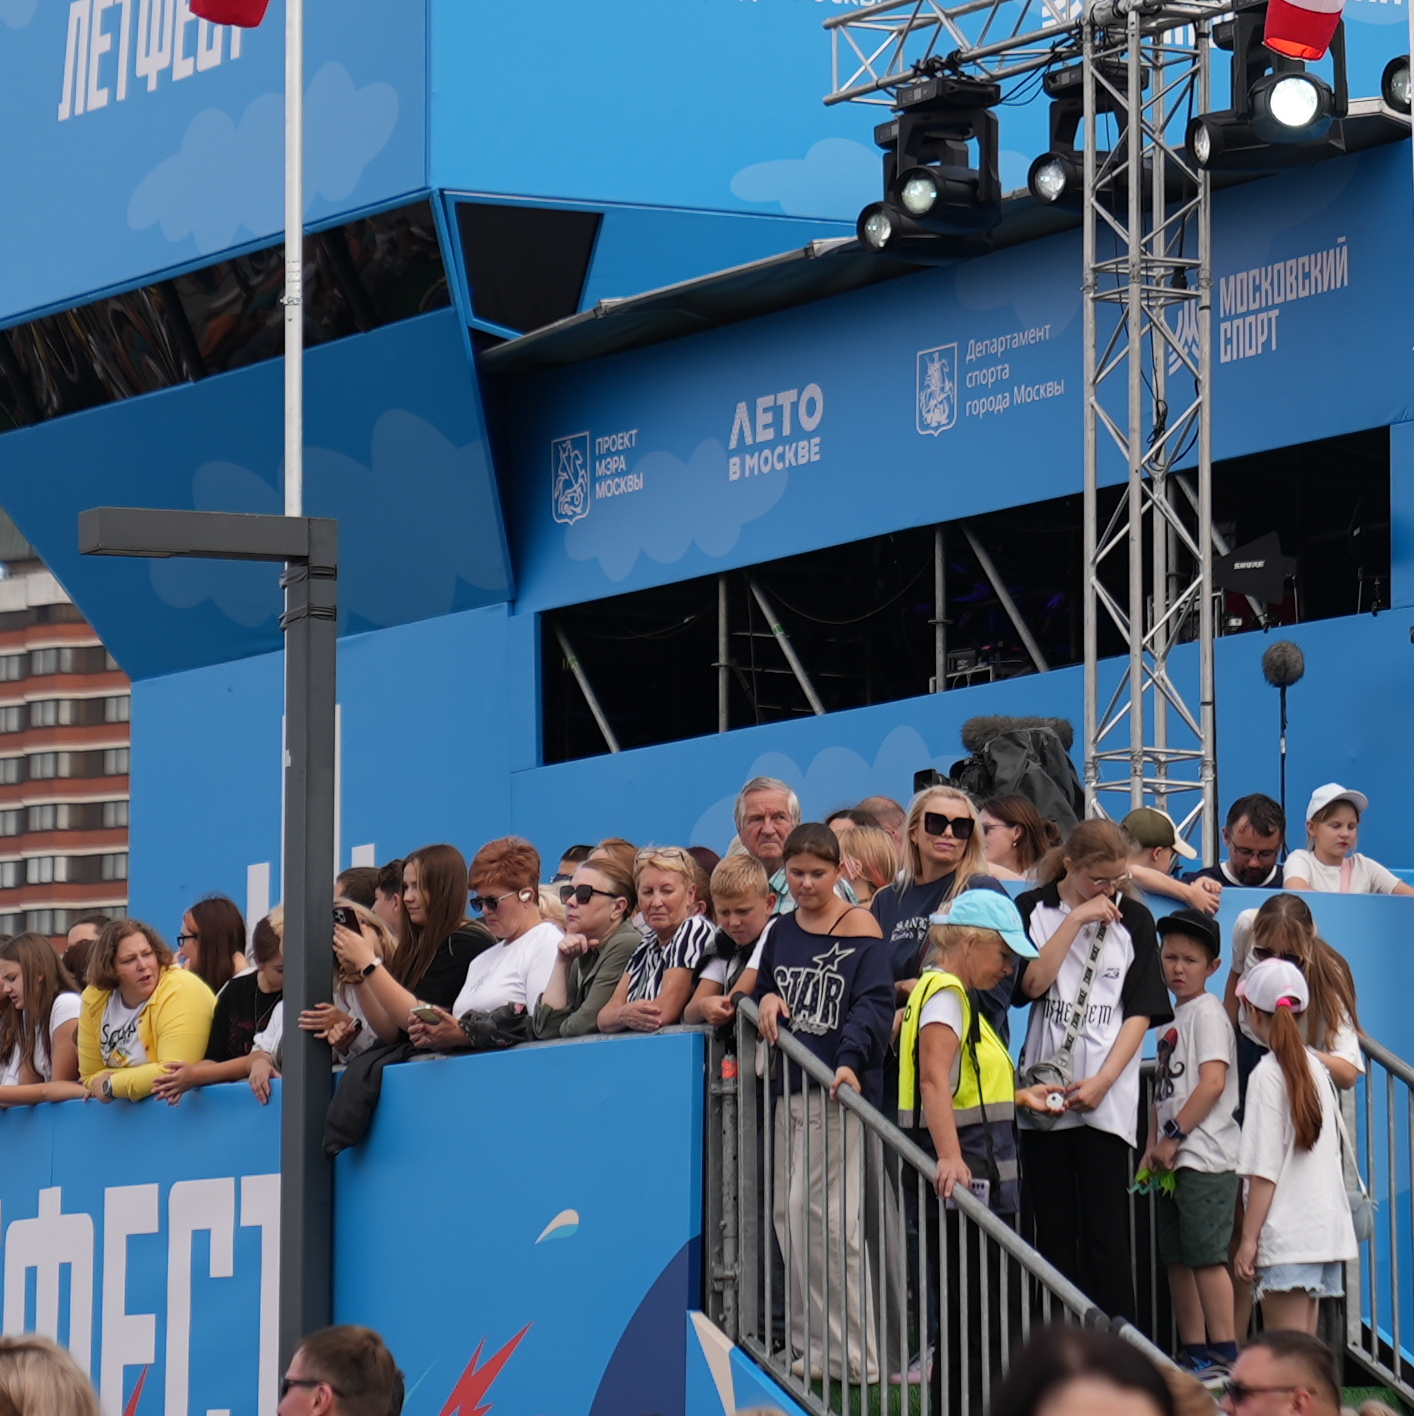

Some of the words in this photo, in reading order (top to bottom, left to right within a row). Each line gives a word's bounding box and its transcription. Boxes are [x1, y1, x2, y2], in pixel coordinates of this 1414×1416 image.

[1219, 236, 1349, 318] МОСКОВСКИЙ
[965, 323, 1051, 365] Департамент
[1220, 309, 1280, 364] СПОРТ
[965, 365, 1010, 389] спорта
[728, 382, 824, 450] ЛЕТО
[965, 387, 1011, 418] города
[1013, 379, 1065, 403] Москвы
[595, 429, 638, 456] ПРОЕКТ
[728, 457, 741, 482] В
[745, 436, 821, 478] МОСКВЕ
[595, 455, 627, 477] МЭРА
[595, 473, 644, 500] МОСКВЫ
